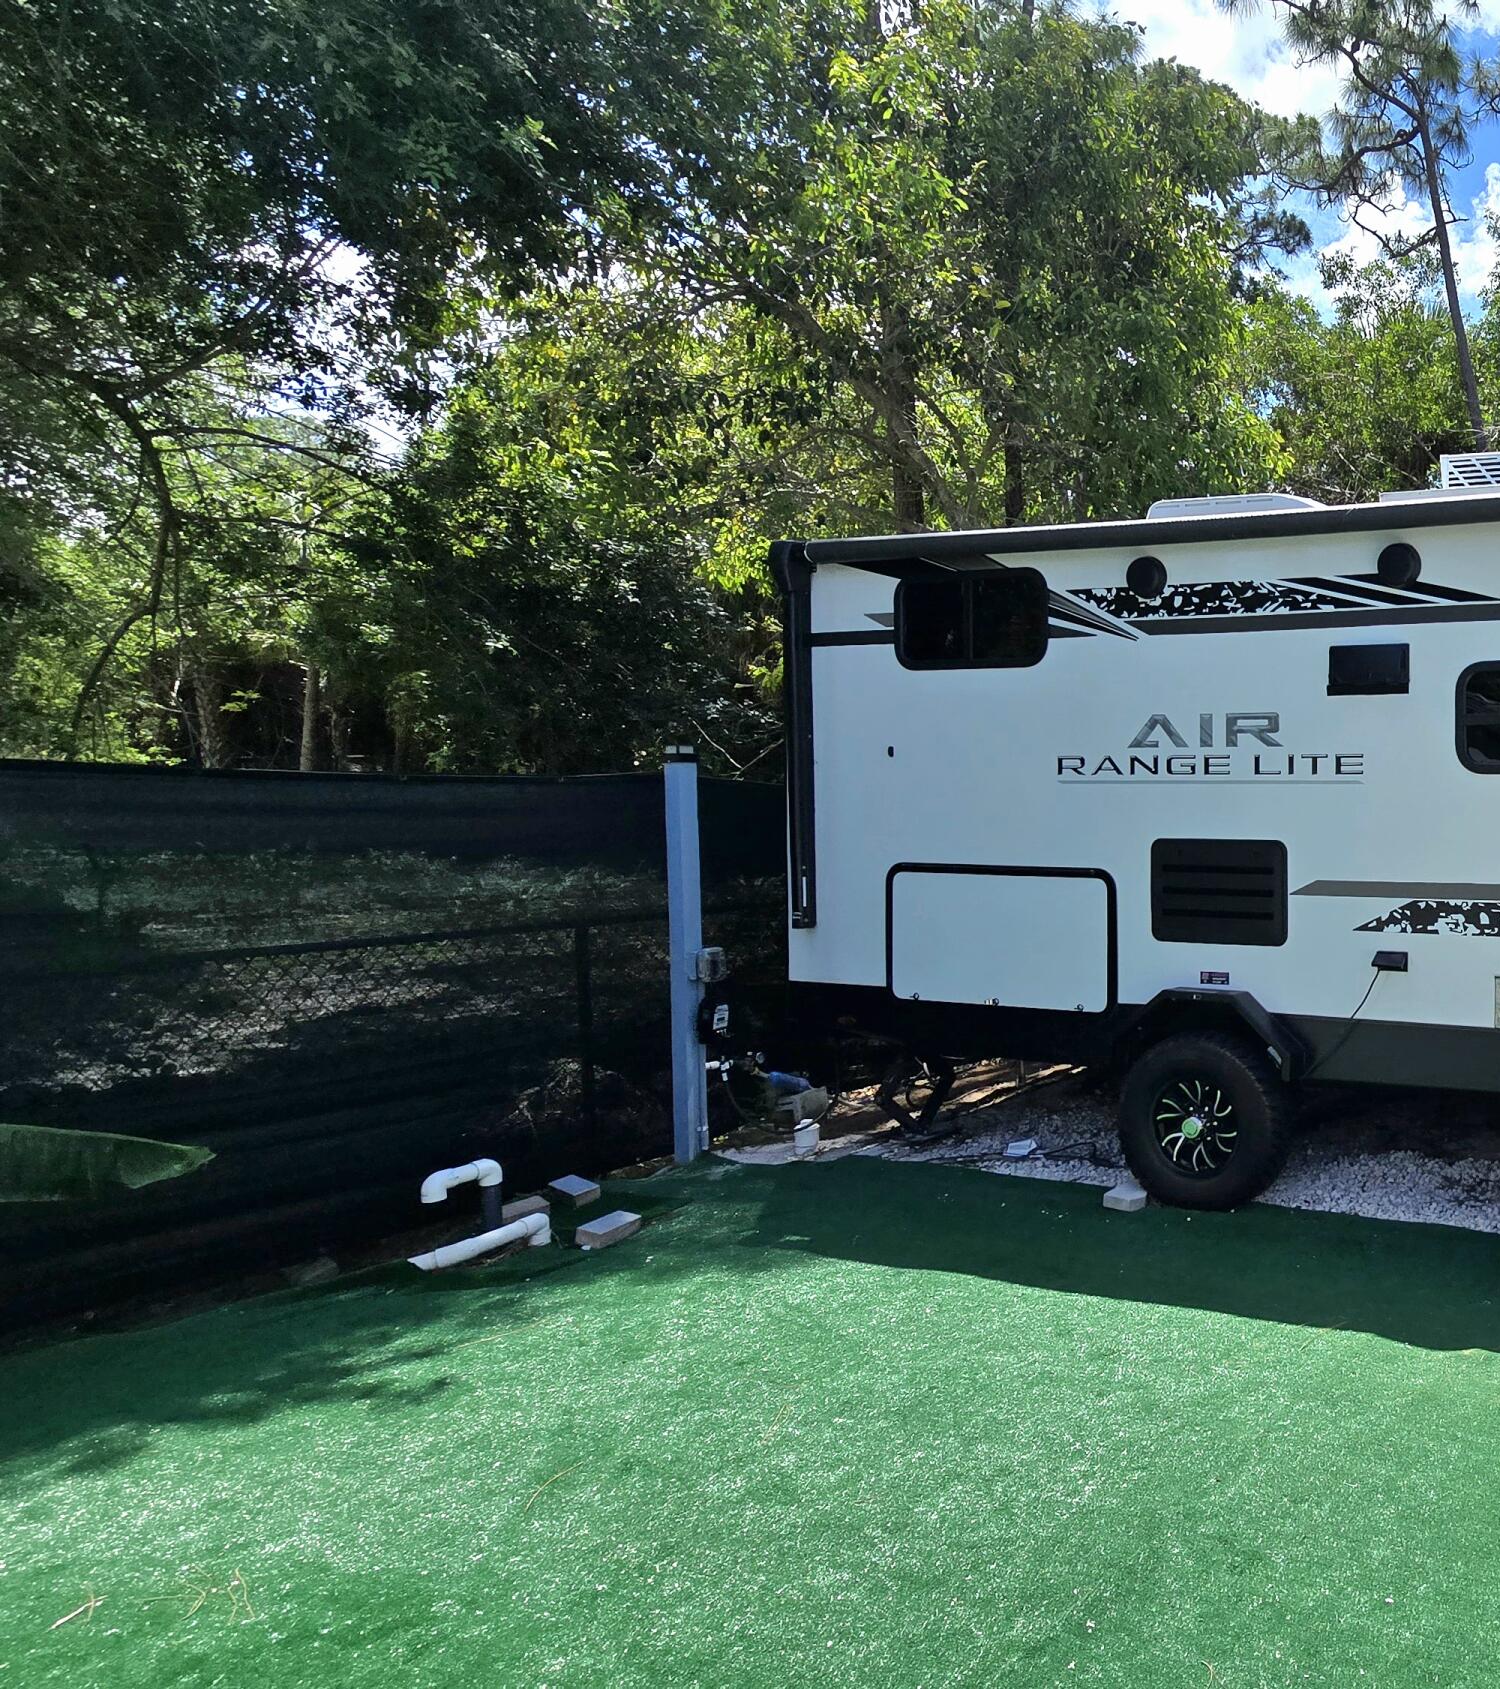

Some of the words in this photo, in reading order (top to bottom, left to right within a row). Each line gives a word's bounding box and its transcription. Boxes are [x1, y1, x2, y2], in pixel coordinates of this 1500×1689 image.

[1127, 711, 1284, 748] AIR
[1056, 754, 1231, 776] RANGE
[1253, 753, 1365, 776] LITE
